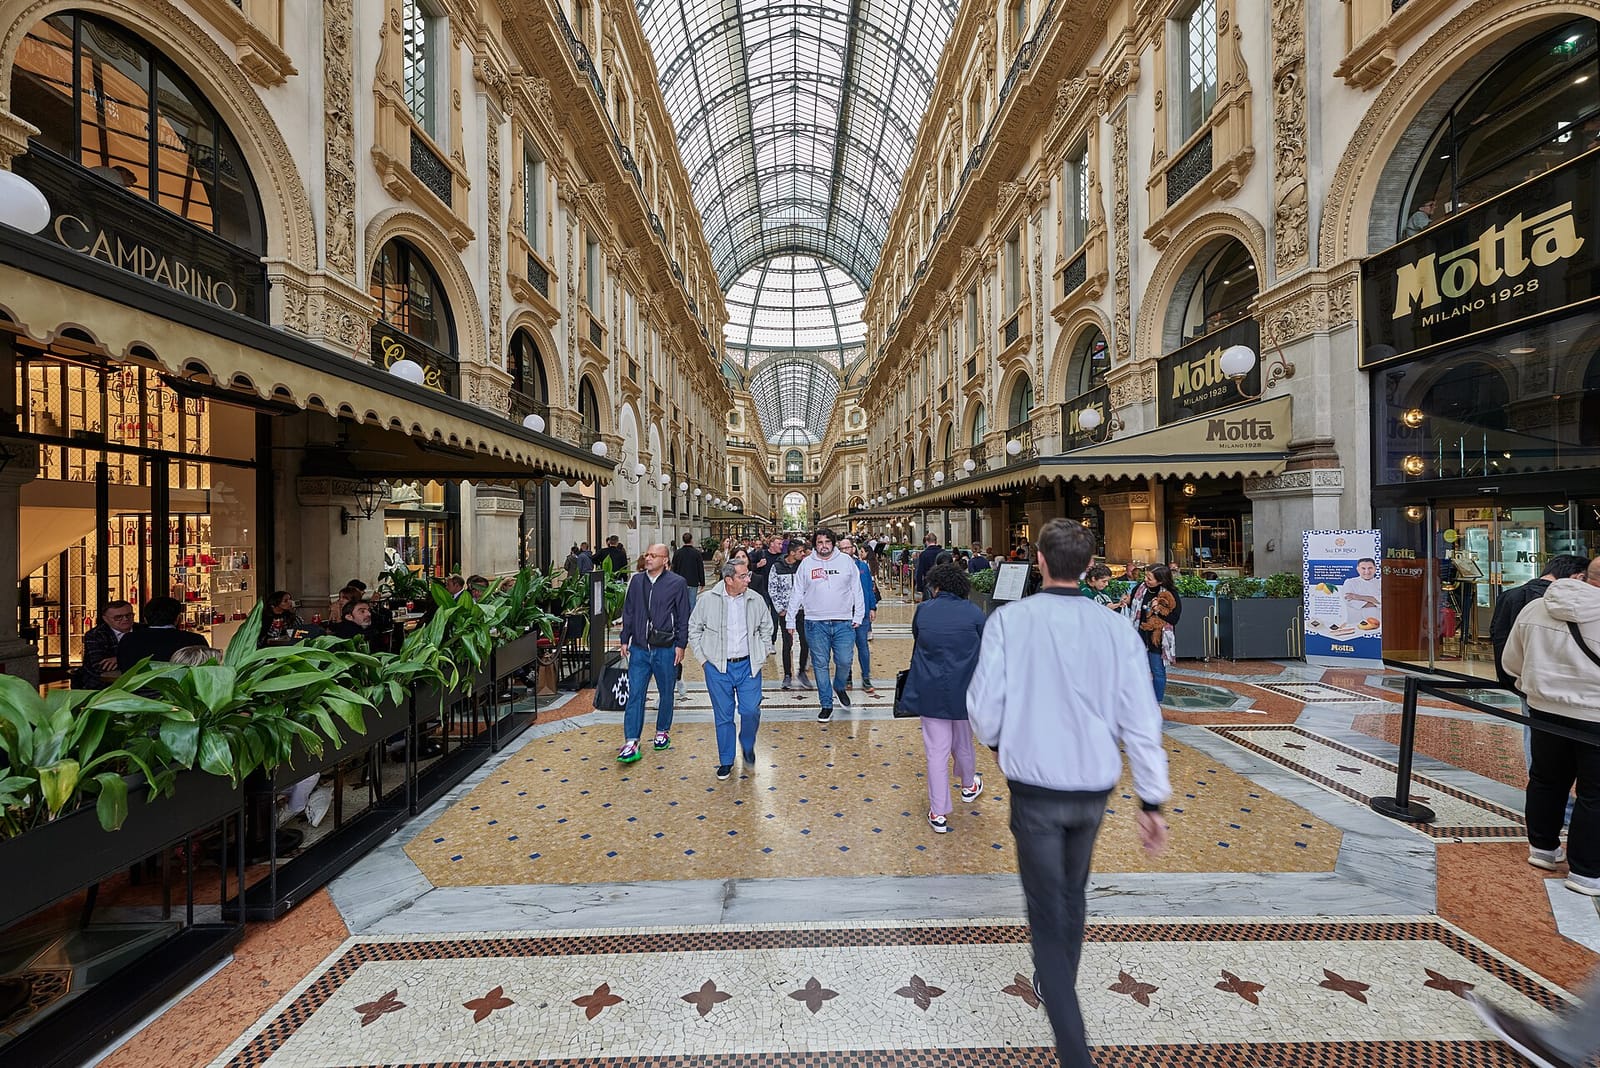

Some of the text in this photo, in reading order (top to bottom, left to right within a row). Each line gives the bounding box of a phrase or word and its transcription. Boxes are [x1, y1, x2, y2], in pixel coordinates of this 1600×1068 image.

[54, 214, 238, 311] CAMPARINO
[1392, 200, 1585, 320] Motta
[1422, 278, 1540, 328] MILANO 1928
[1171, 345, 1232, 399] Mott
[1183, 385, 1228, 407] MILANO 1928
[1206, 417, 1275, 441] Motta
[1386, 547, 1416, 560] Motta
[1445, 549, 1480, 561] Motta
[1330, 644, 1355, 652] Motta
